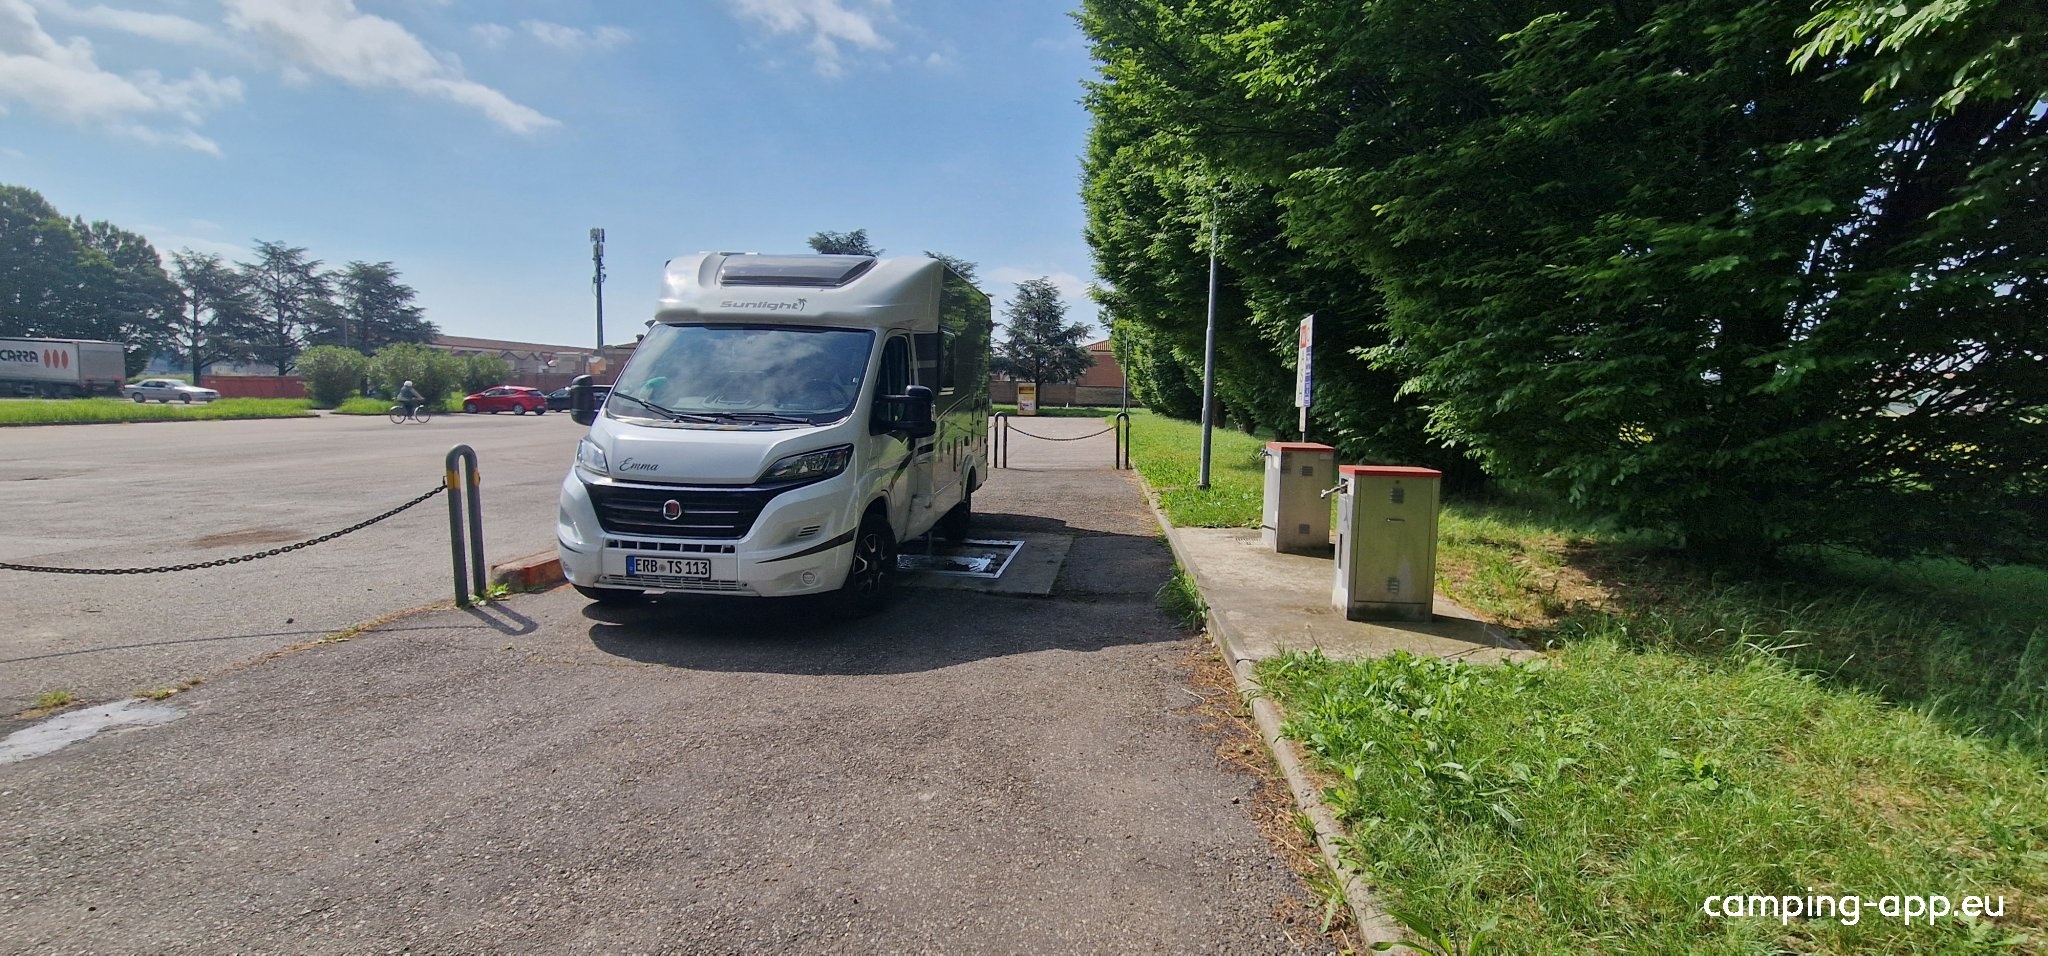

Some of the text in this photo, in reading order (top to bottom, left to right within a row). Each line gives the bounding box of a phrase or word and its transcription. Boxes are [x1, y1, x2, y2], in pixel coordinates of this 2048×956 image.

[719, 300, 799, 311] Sunlight
[619, 457, 660, 472] Emma
[635, 558, 708, 576] ERB TS 113
